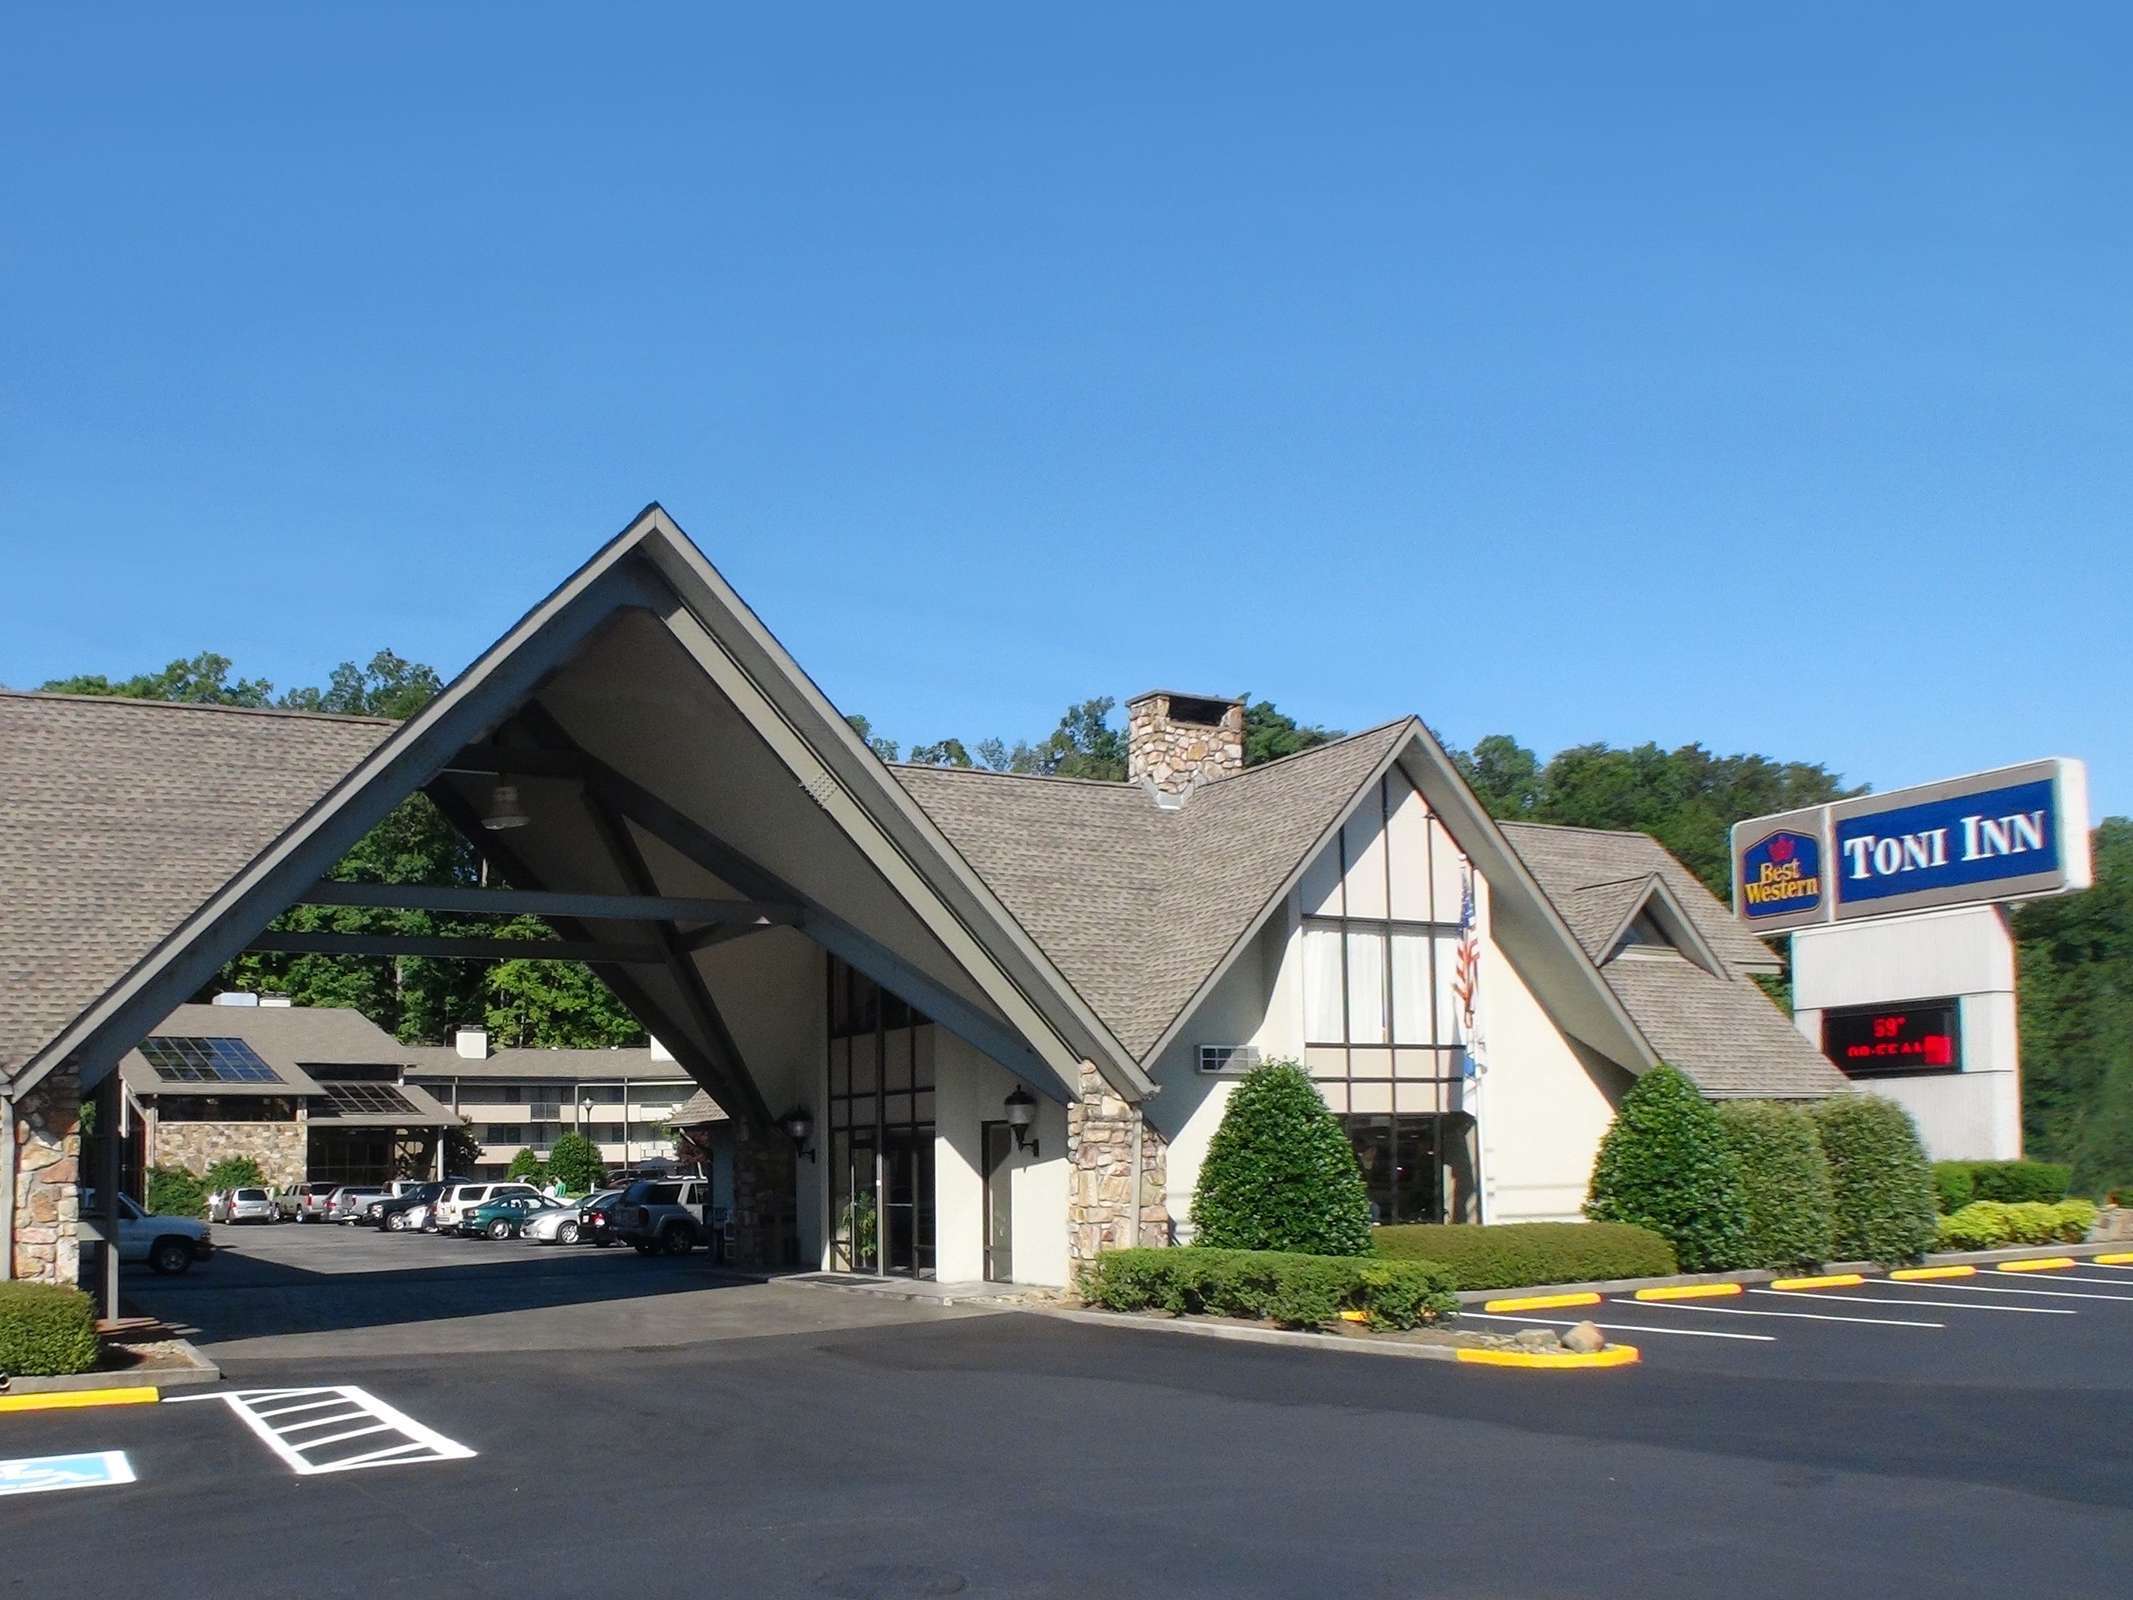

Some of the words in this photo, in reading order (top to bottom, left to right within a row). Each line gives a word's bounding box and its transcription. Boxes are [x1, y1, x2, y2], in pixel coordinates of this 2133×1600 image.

[1844, 829, 1948, 879] TONI
[1961, 811, 2045, 861] INN
[1760, 859, 1800, 884] Best
[1745, 879, 1818, 904] Western
